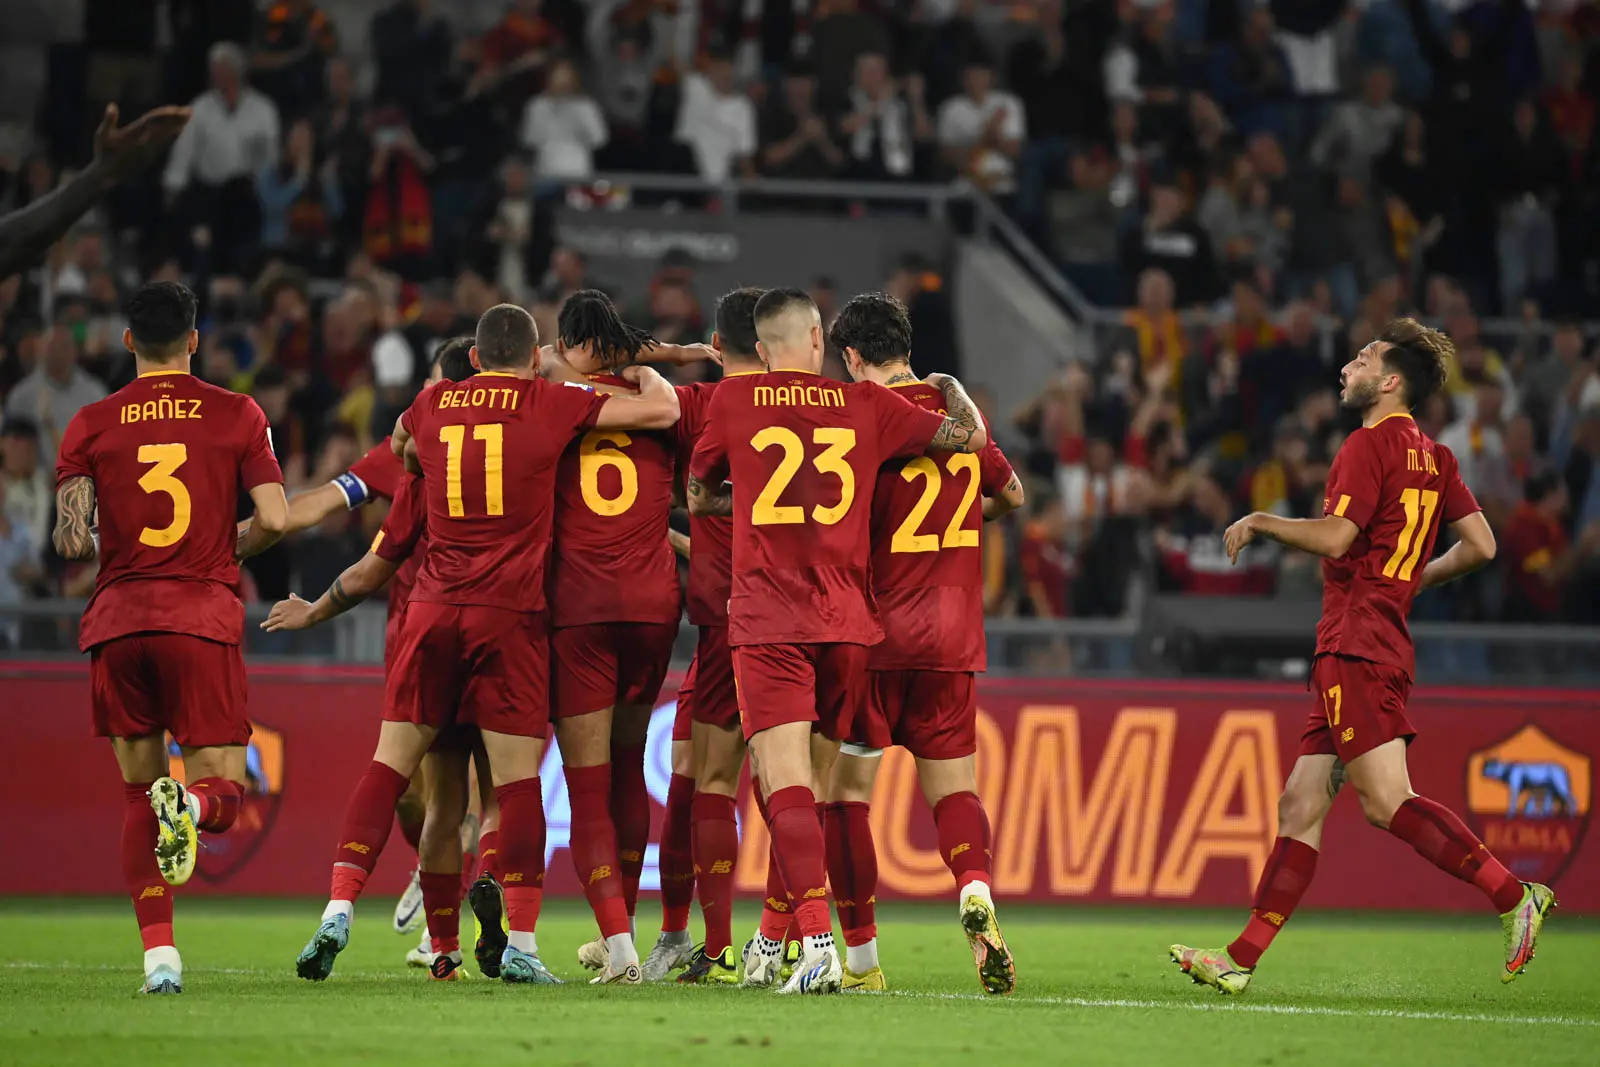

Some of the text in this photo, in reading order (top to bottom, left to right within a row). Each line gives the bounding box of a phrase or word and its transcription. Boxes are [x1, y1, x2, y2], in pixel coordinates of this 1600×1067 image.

[120, 394, 203, 425] IBAÑEZ
[438, 388, 519, 410] BELOTTI
[754, 386, 846, 407] MANCINI
[137, 443, 192, 548] 3
[439, 423, 504, 517] 11
[579, 431, 638, 517] 6
[750, 426, 857, 526] 23
[890, 452, 981, 553] 22
[1382, 488, 1440, 582] 17
